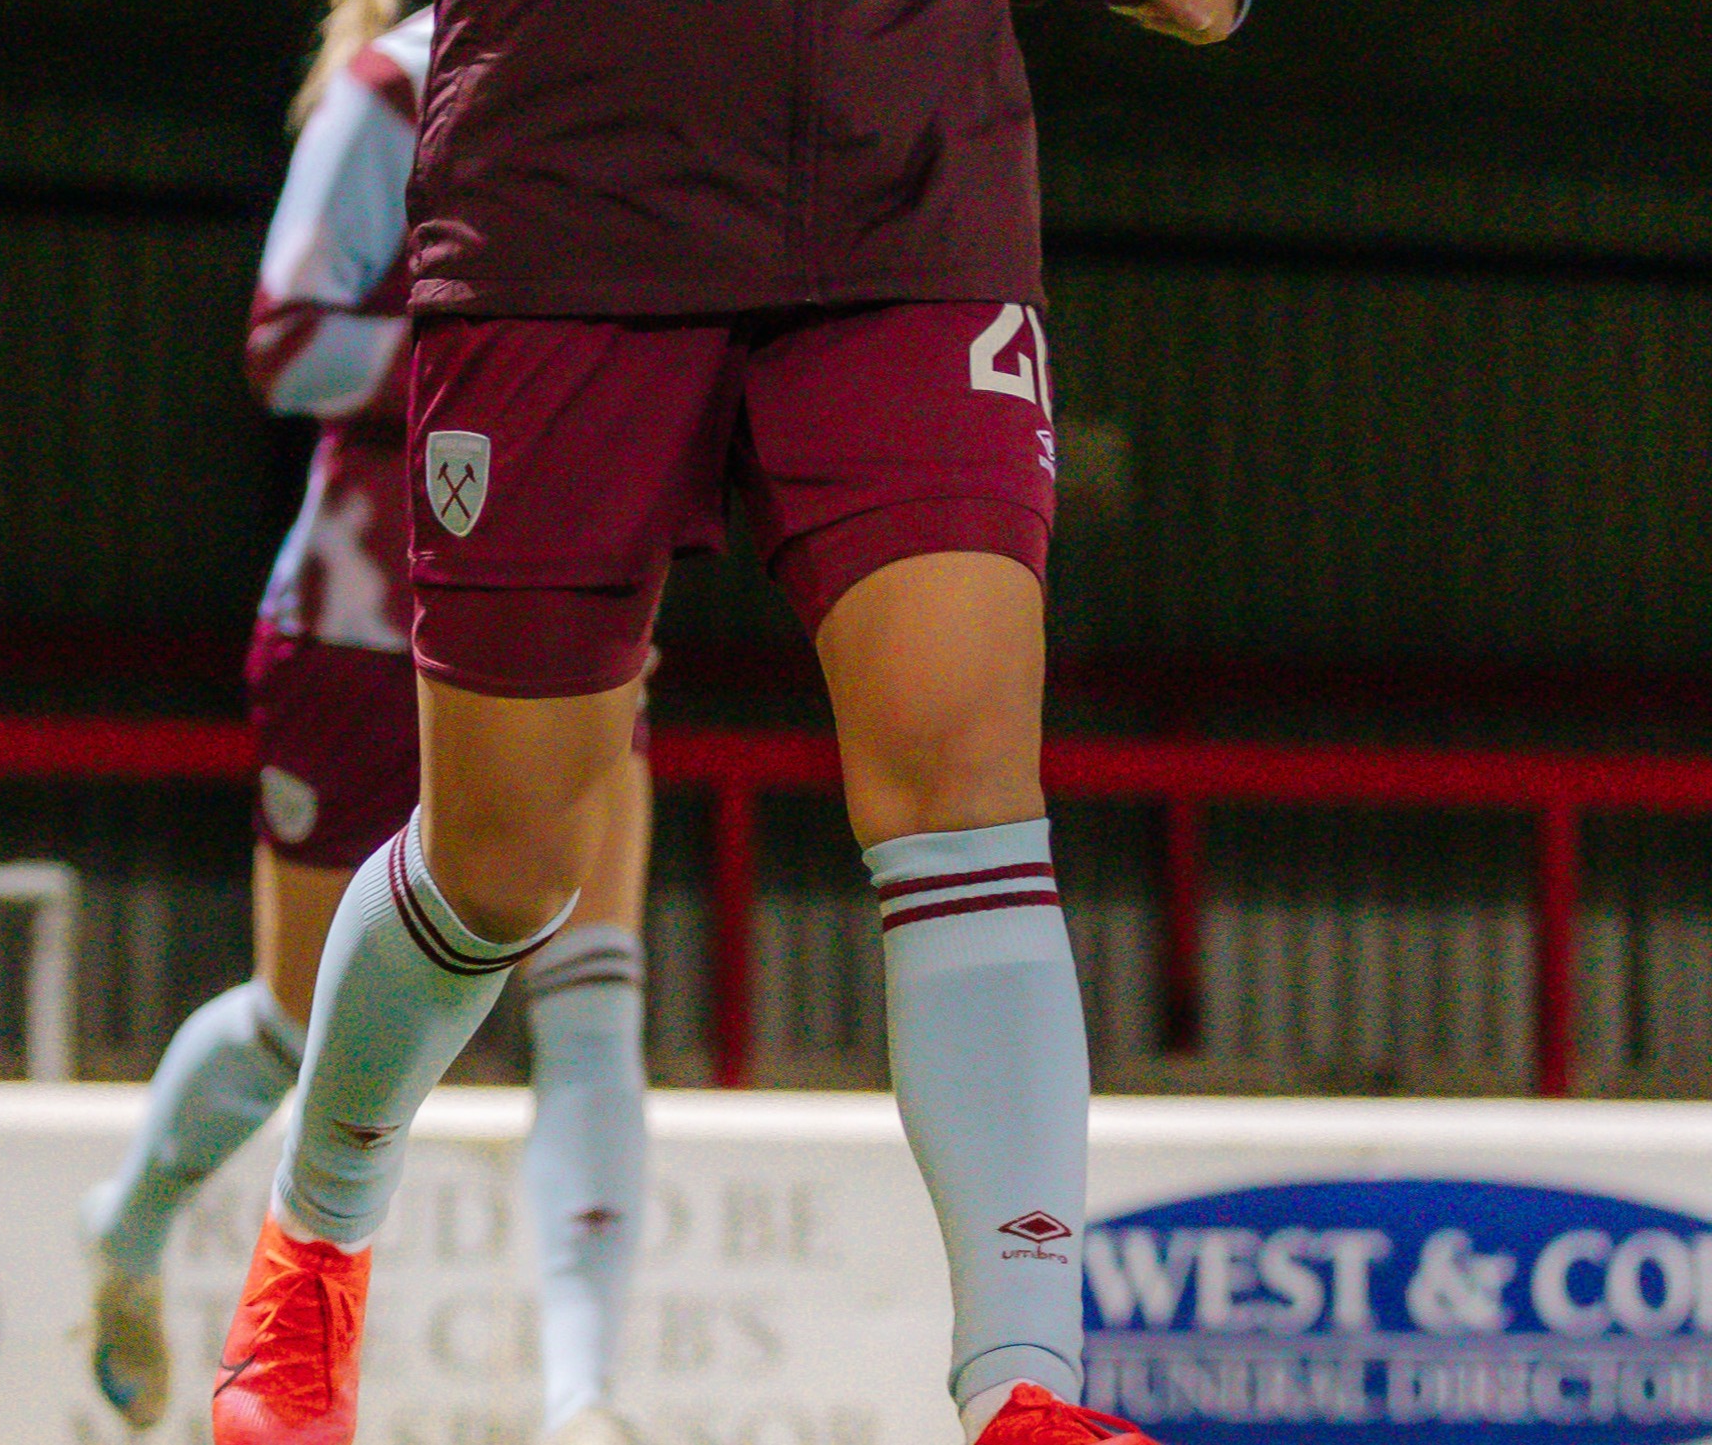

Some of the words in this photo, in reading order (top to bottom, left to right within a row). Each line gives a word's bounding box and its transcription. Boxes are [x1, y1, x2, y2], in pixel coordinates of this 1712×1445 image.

[1002, 1245, 1068, 1264] umbro
[1084, 1227, 1392, 1332] WEST
[1405, 1227, 1518, 1334] &
